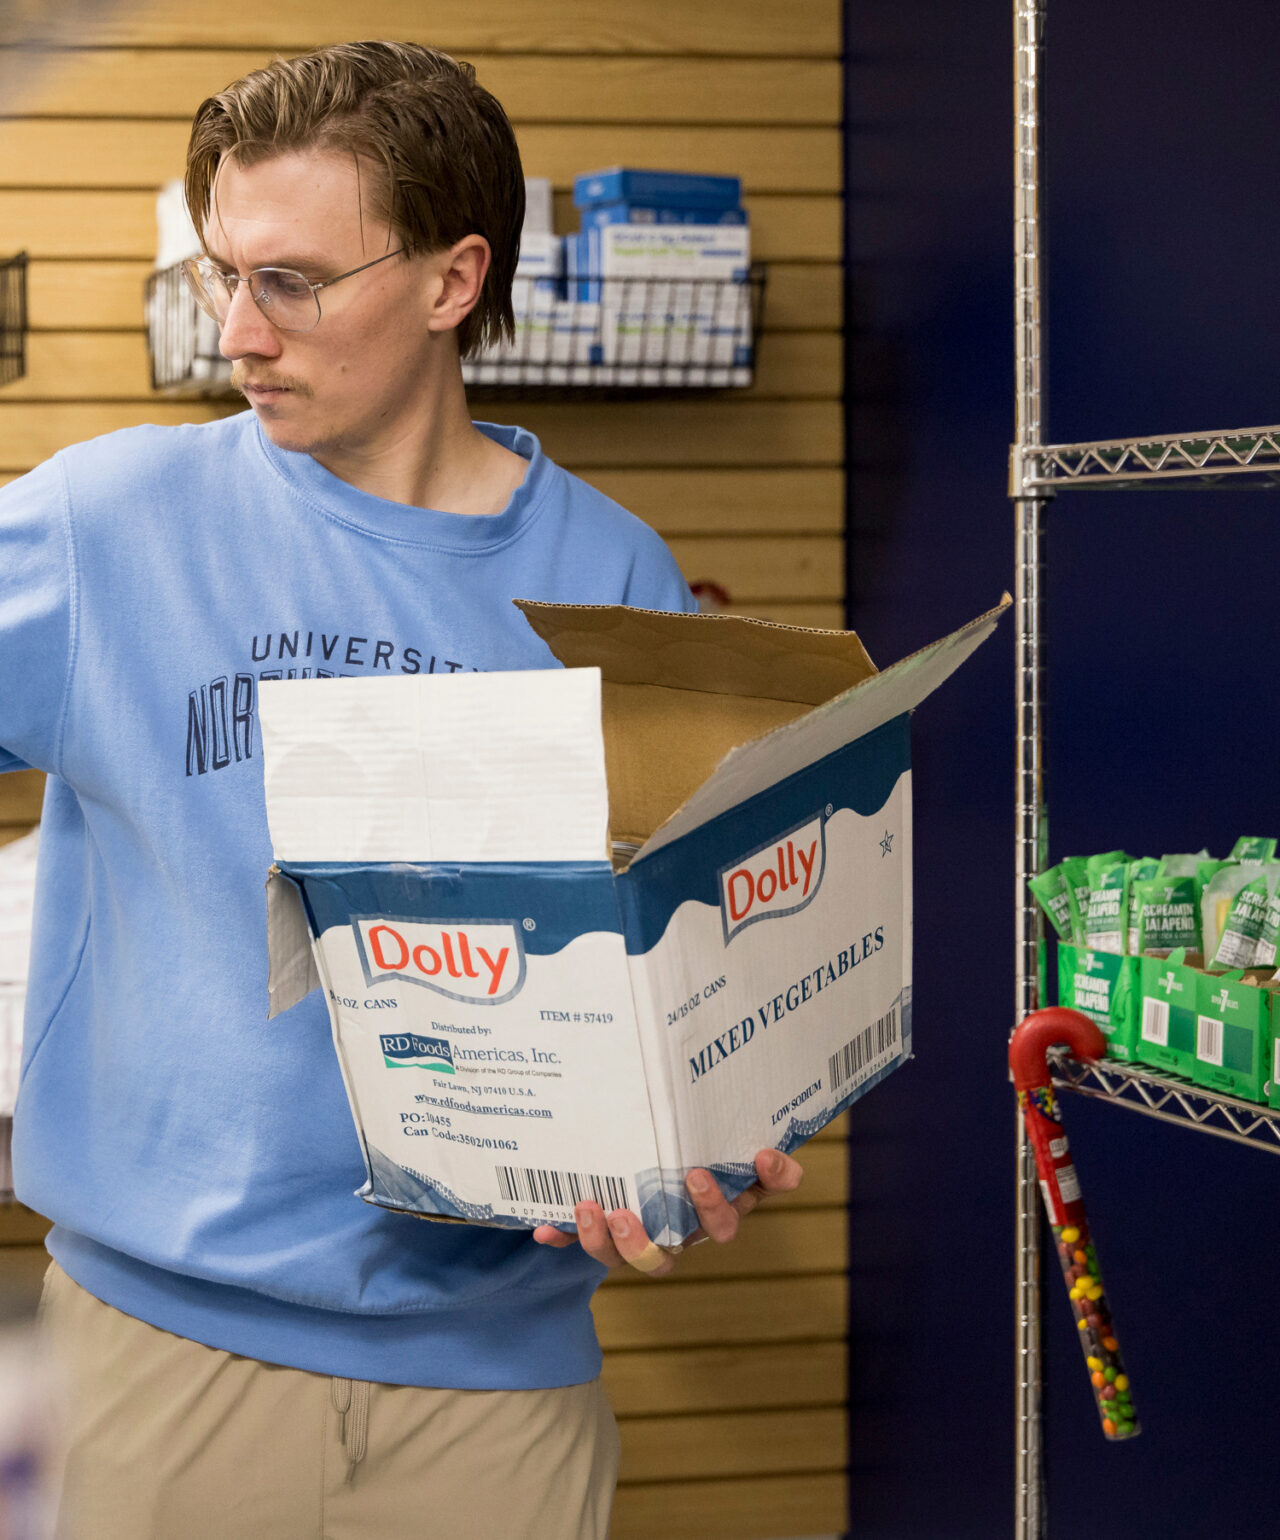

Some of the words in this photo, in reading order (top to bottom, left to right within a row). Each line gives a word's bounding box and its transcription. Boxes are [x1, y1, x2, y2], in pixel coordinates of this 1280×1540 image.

[251, 630, 488, 676] UNIVERSIT
[727, 839, 818, 922] Dolly
[368, 925, 510, 995] Dolly
[342, 998, 358, 1009] OZ
[364, 998, 398, 1009] CANS
[688, 1015, 756, 1084] MIXED
[757, 925, 885, 1030] VEGETABLES
[689, 993, 701, 1011] OZ
[703, 975, 727, 999] CANS
[431, 1021, 476, 1034] Distributed
[478, 1026, 492, 1036] by:
[539, 1010, 571, 1022] ITEM
[573, 1012, 581, 1022] #
[583, 1012, 614, 1024] 57419
[381, 1036, 411, 1053] RD
[411, 1036, 451, 1058] Foods
[453, 1044, 529, 1064] Americas,
[532, 1047, 562, 1064] Inc.
[432, 1078, 446, 1088] Fair
[448, 1081, 470, 1093] Lawn,
[470, 1086, 482, 1096] NJ
[483, 1086, 507, 1096] 07410
[508, 1087, 537, 1097] U.S.A.
[414, 1093, 553, 1118] www.rdfoodsamericas.com
[771, 1104, 790, 1126] LOW
[791, 1078, 822, 1110] SODIUM
[403, 1126, 429, 1137] Can
